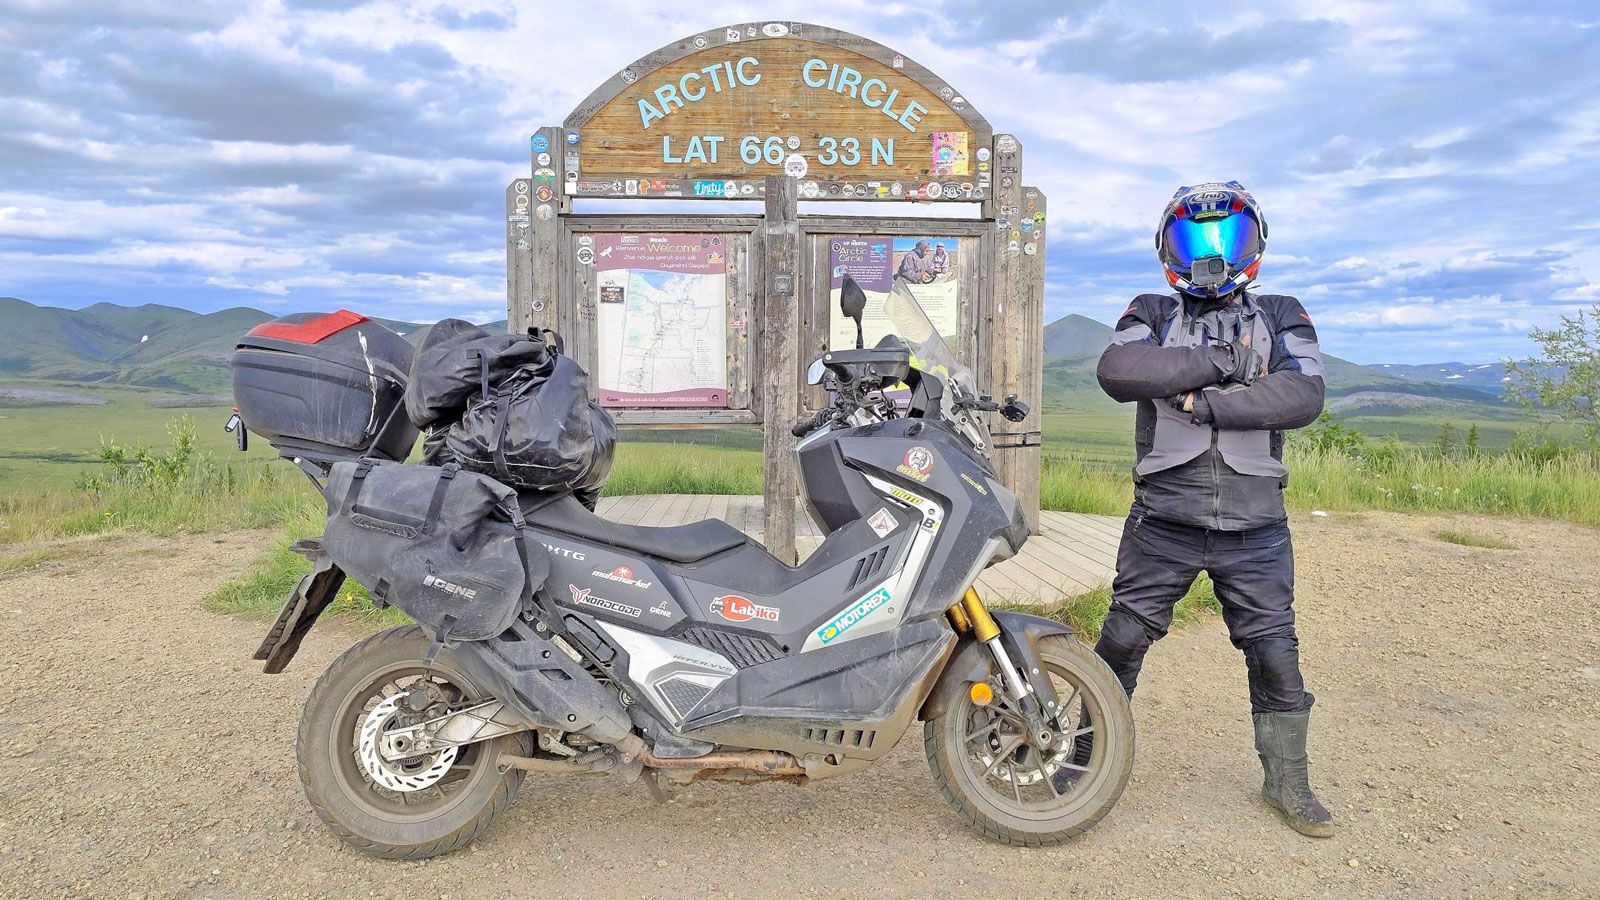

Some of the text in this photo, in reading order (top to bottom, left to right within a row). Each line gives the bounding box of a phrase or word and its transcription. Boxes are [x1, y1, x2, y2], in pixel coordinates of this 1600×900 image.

[637, 56, 929, 133] ARCTIC CIRCLE
[663, 135, 894, 166] LAT 66 33 N
[943, 186, 962, 195] 805
[646, 243, 701, 253] Welcome
[838, 247, 868, 255] Arctic
[838, 254, 864, 262] Circle
[592, 569, 652, 589] motomarket
[582, 595, 642, 617] NORDCODE
[730, 602, 777, 620] Labiko
[835, 590, 888, 632] MOTOREX
